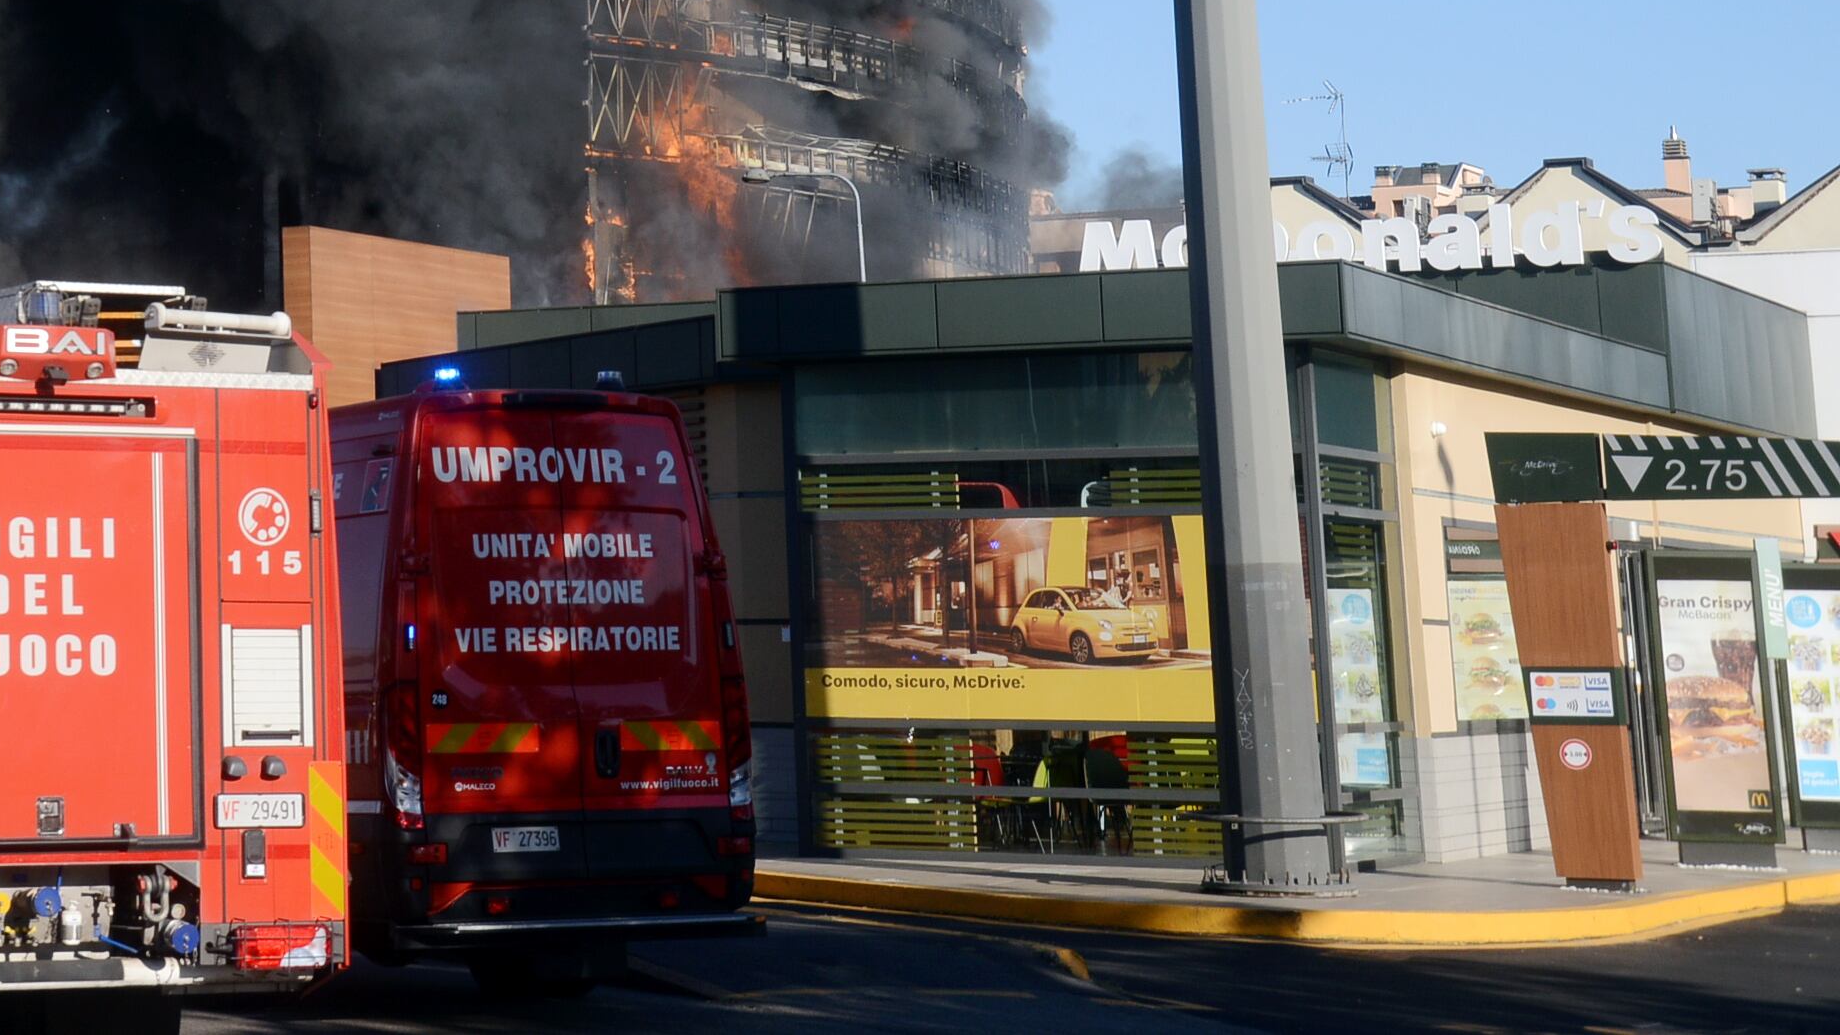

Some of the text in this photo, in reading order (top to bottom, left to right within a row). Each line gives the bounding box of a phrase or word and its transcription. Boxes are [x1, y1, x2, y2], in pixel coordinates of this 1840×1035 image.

[6, 327, 105, 356] BAI
[432, 446, 625, 483] UMPROVIR
[656, 450, 677, 484] 2
[1664, 459, 1748, 492] 2.75
[472, 533, 654, 559] UNITA' MOBILE
[489, 579, 644, 605] PROTEZIONE
[1764, 567, 1785, 628] MENU'
[1658, 595, 1753, 612] Gran Crispy
[455, 626, 680, 653] VIE RESPIRATORIE
[822, 673, 892, 690] Comodo,
[895, 673, 950, 691] sicuro,
[1587, 677, 1608, 686] VISA
[432, 693, 448, 706] 248
[1589, 700, 1610, 709] VISA
[620, 778, 719, 791] www.vigilfuoco.it
[222, 800, 297, 821] VF 29491
[495, 830, 557, 848] VF 27396
